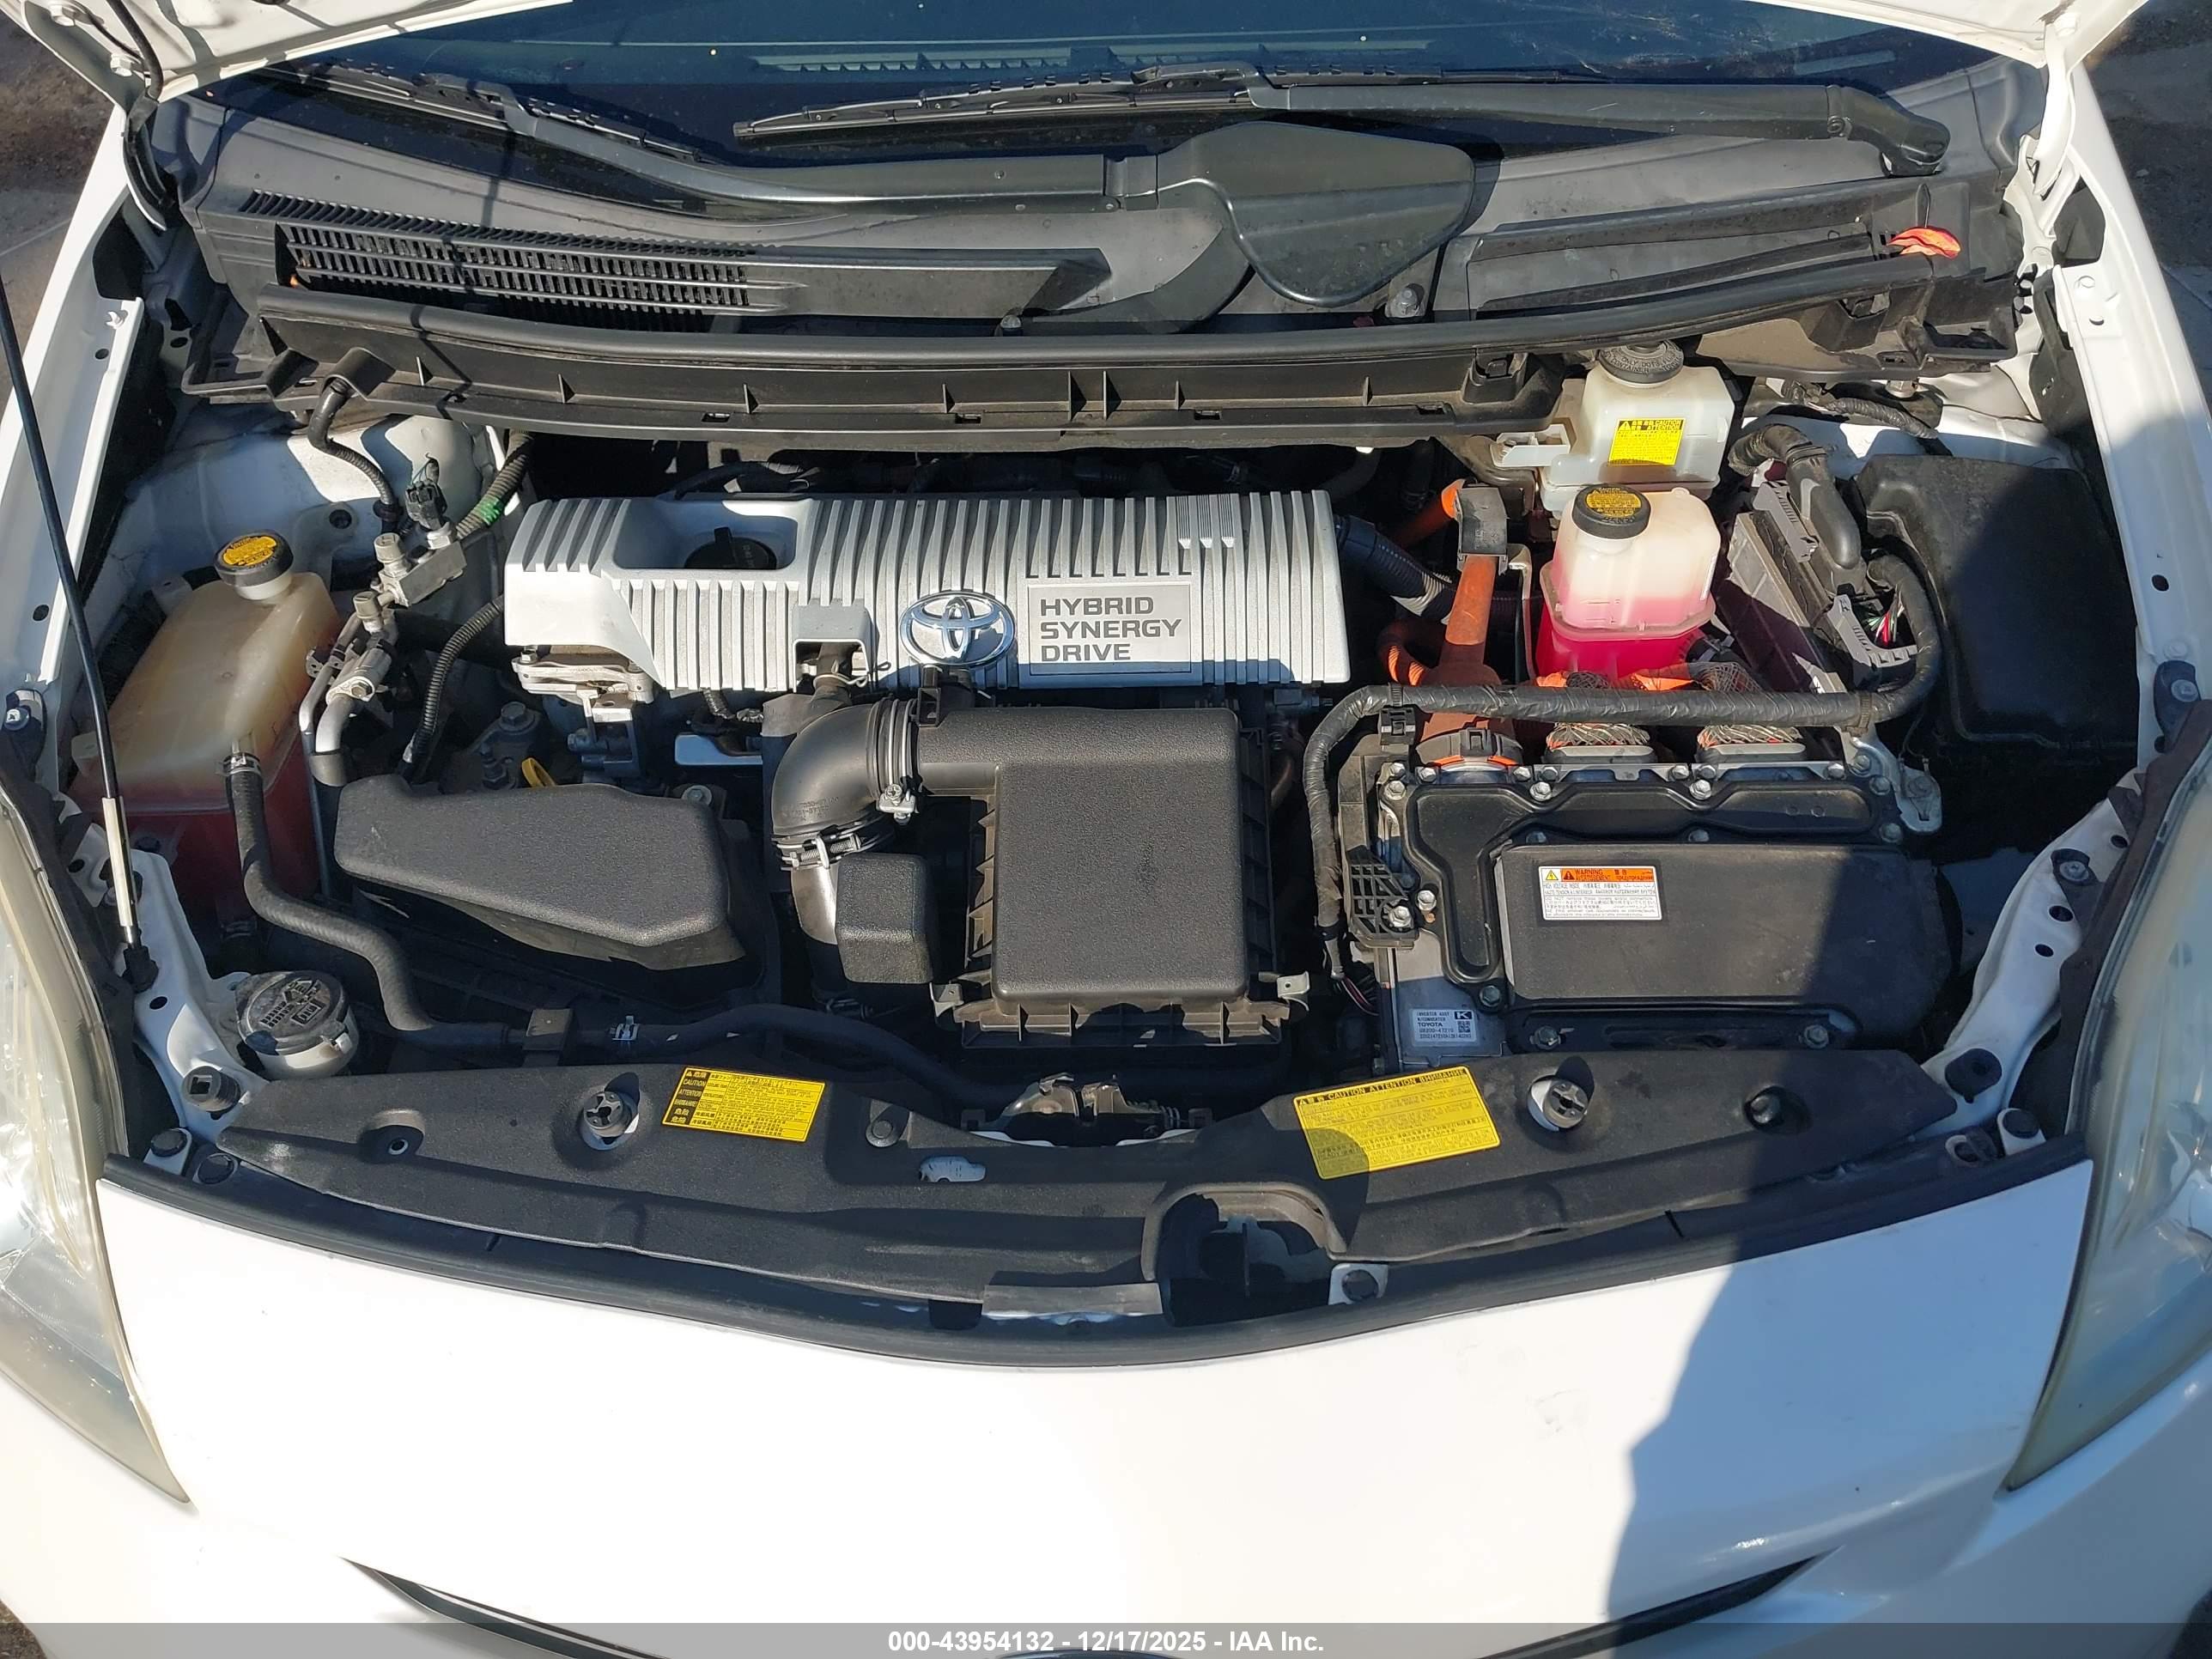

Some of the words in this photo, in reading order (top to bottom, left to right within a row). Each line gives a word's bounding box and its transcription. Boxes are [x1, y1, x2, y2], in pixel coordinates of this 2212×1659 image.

[1041, 597, 1153, 616] HYBRID
[1041, 619, 1182, 639] SYNERGY
[1041, 643, 1131, 661] DRIVE
[1328, 1087, 1365, 1099] CAUTION
[1370, 1078, 1415, 1092] ATTENTION
